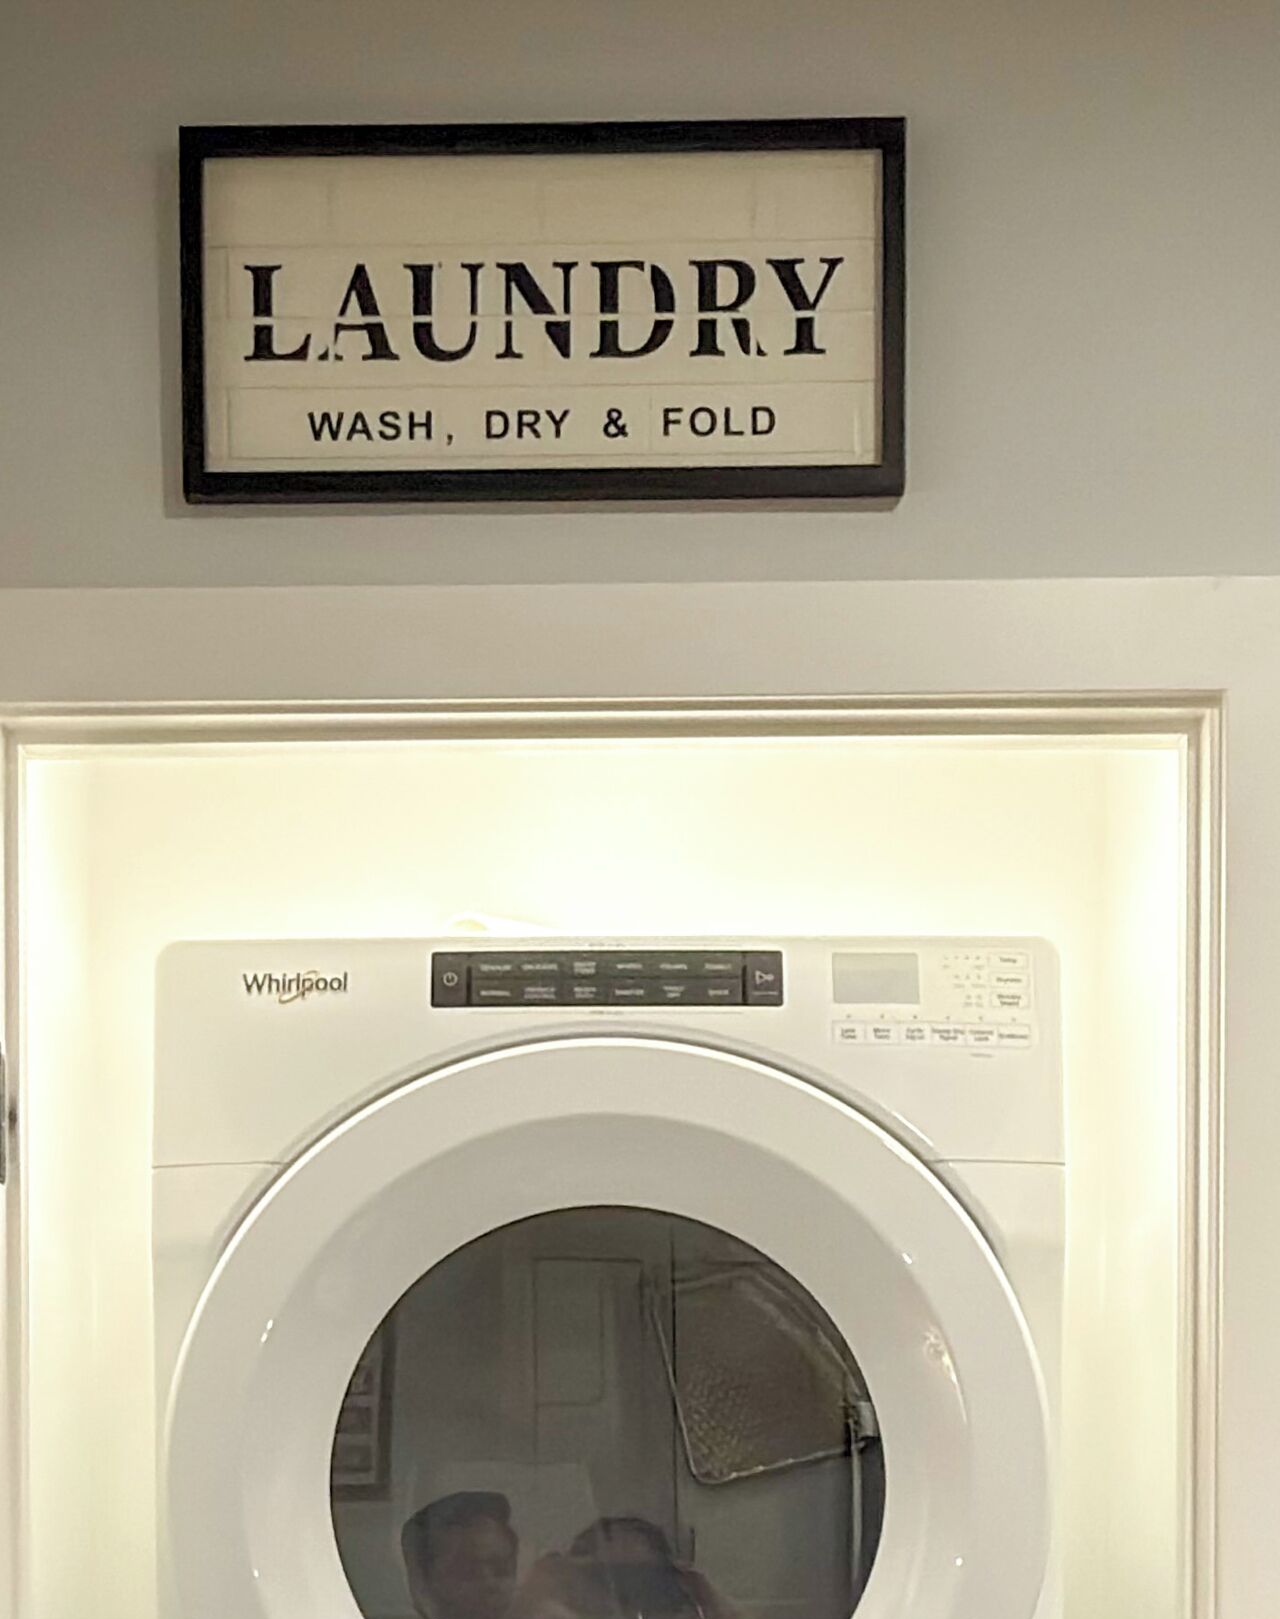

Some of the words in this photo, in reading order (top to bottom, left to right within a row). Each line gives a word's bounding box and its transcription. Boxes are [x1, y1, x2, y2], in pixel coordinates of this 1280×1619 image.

[243, 256, 846, 363] LAUNDRY
[307, 410, 455, 446] WASH,
[485, 409, 570, 440] DRY
[602, 407, 629, 439] &
[662, 406, 777, 437] FOLD
[242, 970, 348, 1003] Whirlpool
